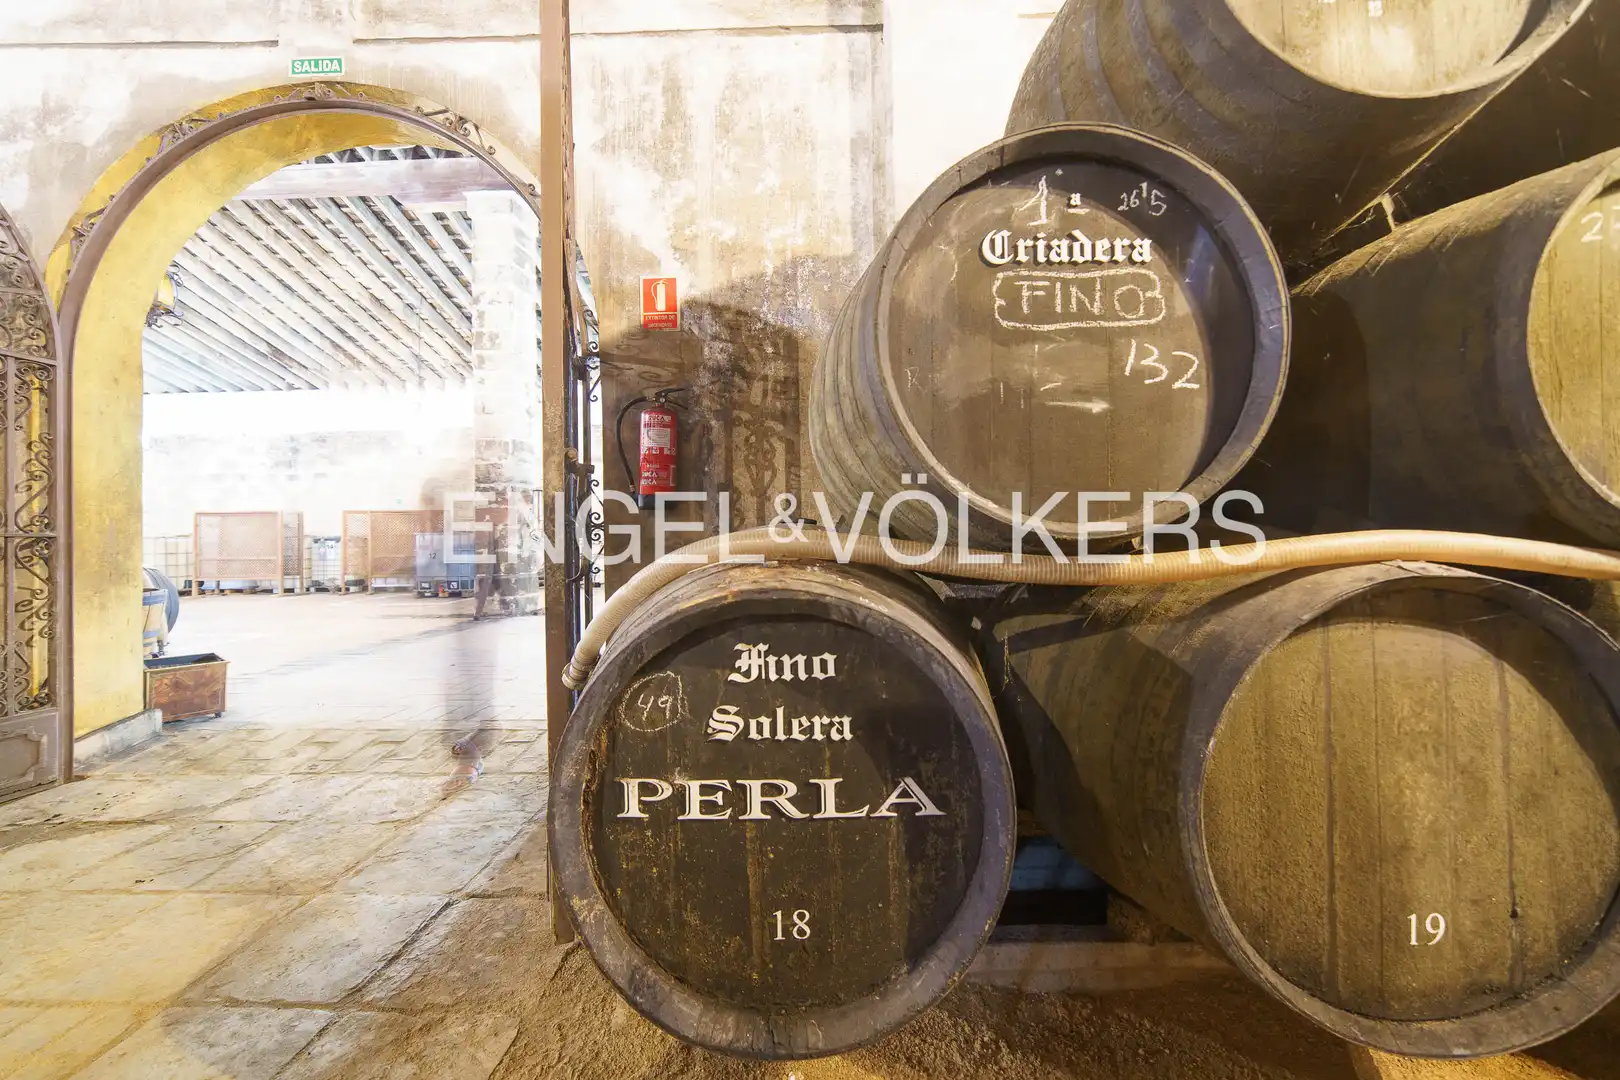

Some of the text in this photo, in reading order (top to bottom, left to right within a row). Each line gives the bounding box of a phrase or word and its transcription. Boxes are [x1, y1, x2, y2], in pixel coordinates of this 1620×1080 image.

[293, 59, 341, 73] SALIDA
[981, 229, 1153, 265] Criadera
[1014, 277, 1146, 319] FINO
[1123, 338, 1201, 389] 132
[727, 642, 837, 683] Fino
[707, 705, 853, 742] Solera
[616, 776, 947, 820] PERLA
[772, 909, 811, 941] 18
[1407, 912, 1446, 946] 19
